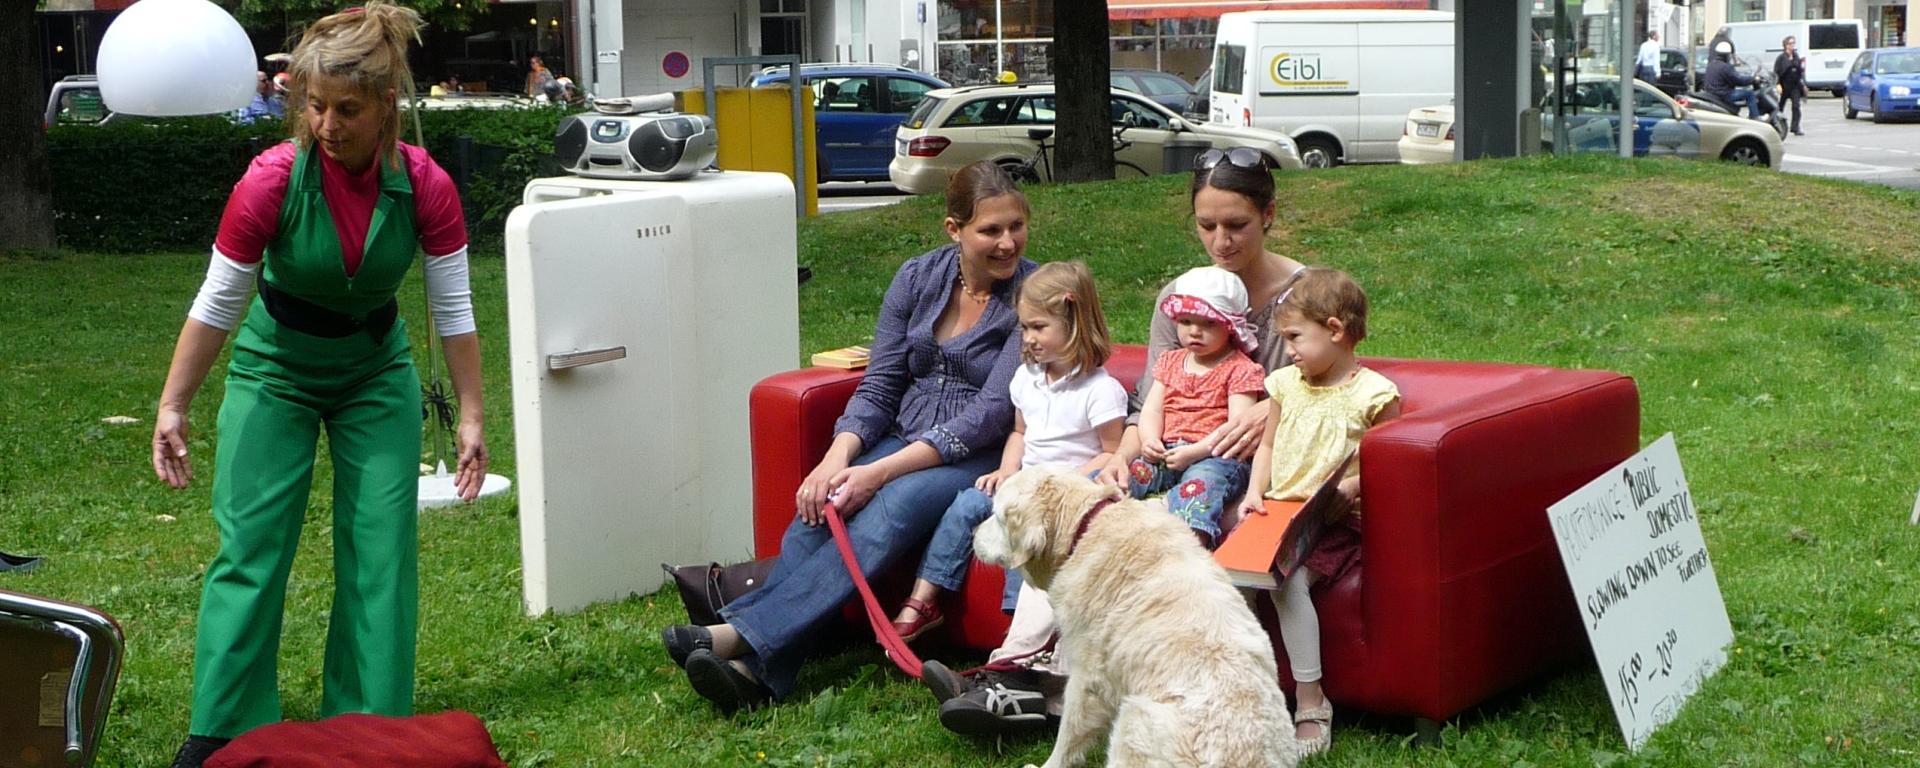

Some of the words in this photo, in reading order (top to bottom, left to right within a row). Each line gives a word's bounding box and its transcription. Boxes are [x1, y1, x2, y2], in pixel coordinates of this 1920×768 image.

[1277, 57, 1321, 80] Eibl
[637, 225, 671, 239] BOSCH
[1646, 479, 1694, 539] DOMESTIC
[1587, 570, 1629, 631] SLOWING
[1626, 551, 1659, 590] DOWN
[1655, 546, 1668, 570] TO
[1666, 541, 1684, 564] SEE
